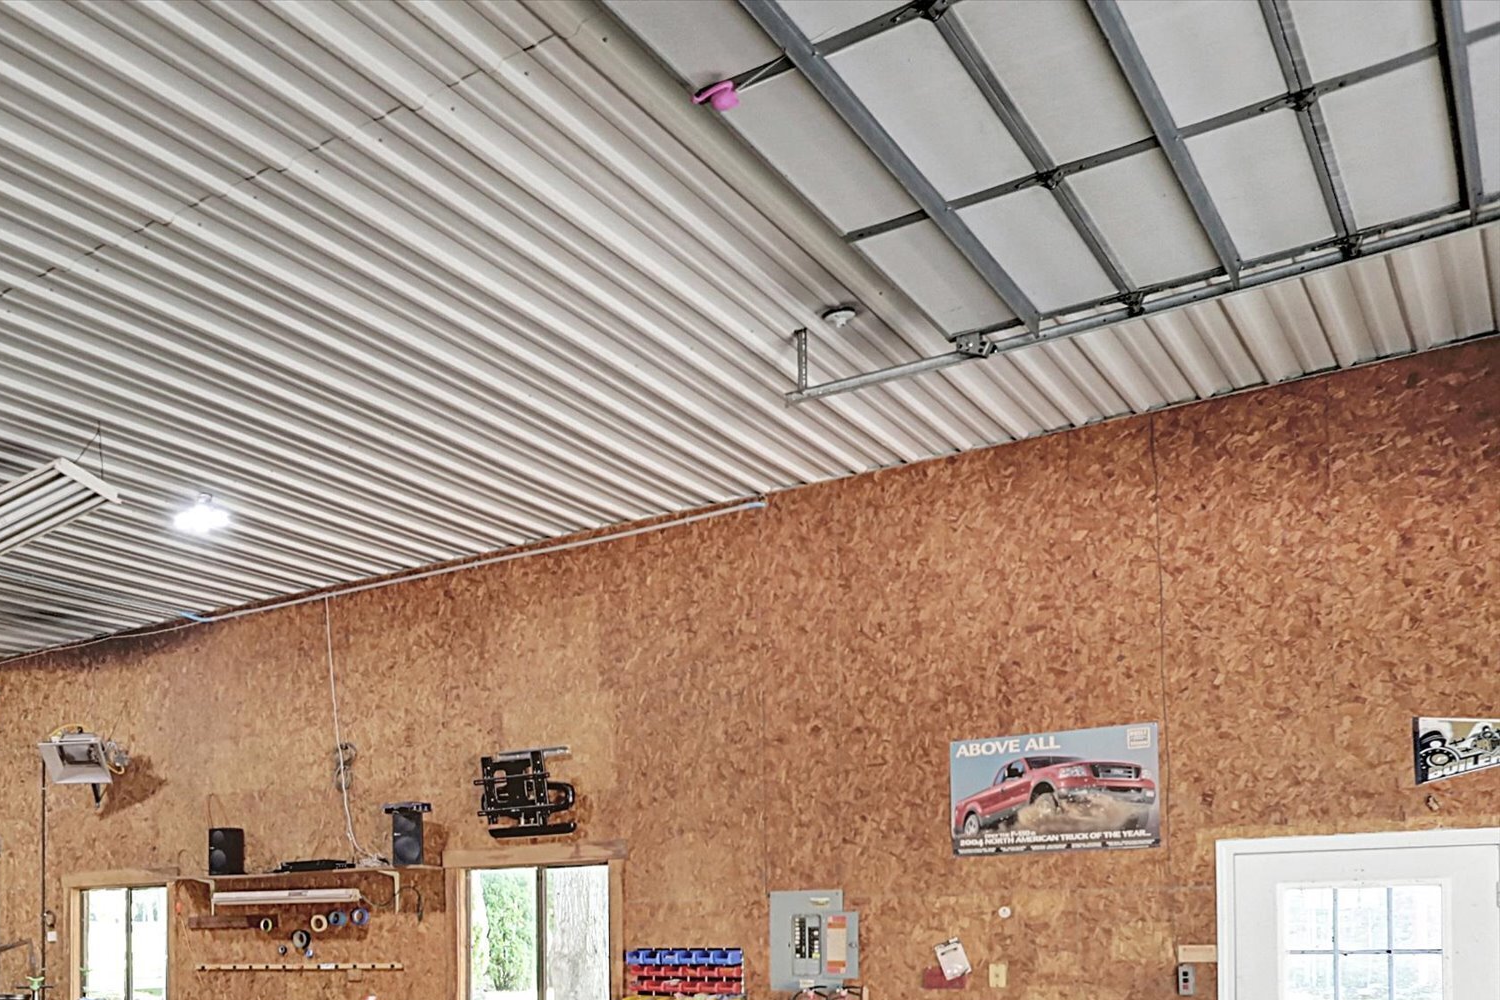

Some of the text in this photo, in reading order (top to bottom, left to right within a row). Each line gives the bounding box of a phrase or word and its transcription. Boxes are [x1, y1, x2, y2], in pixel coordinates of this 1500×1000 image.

[956, 736, 1061, 758] ABOVE ALL
[984, 836, 1014, 846] NORTH
[1015, 833, 1060, 844] AMERICAN
[1060, 832, 1089, 841] TRUCK
[1089, 831, 1102, 840] OF
[1103, 830, 1121, 839] THE
